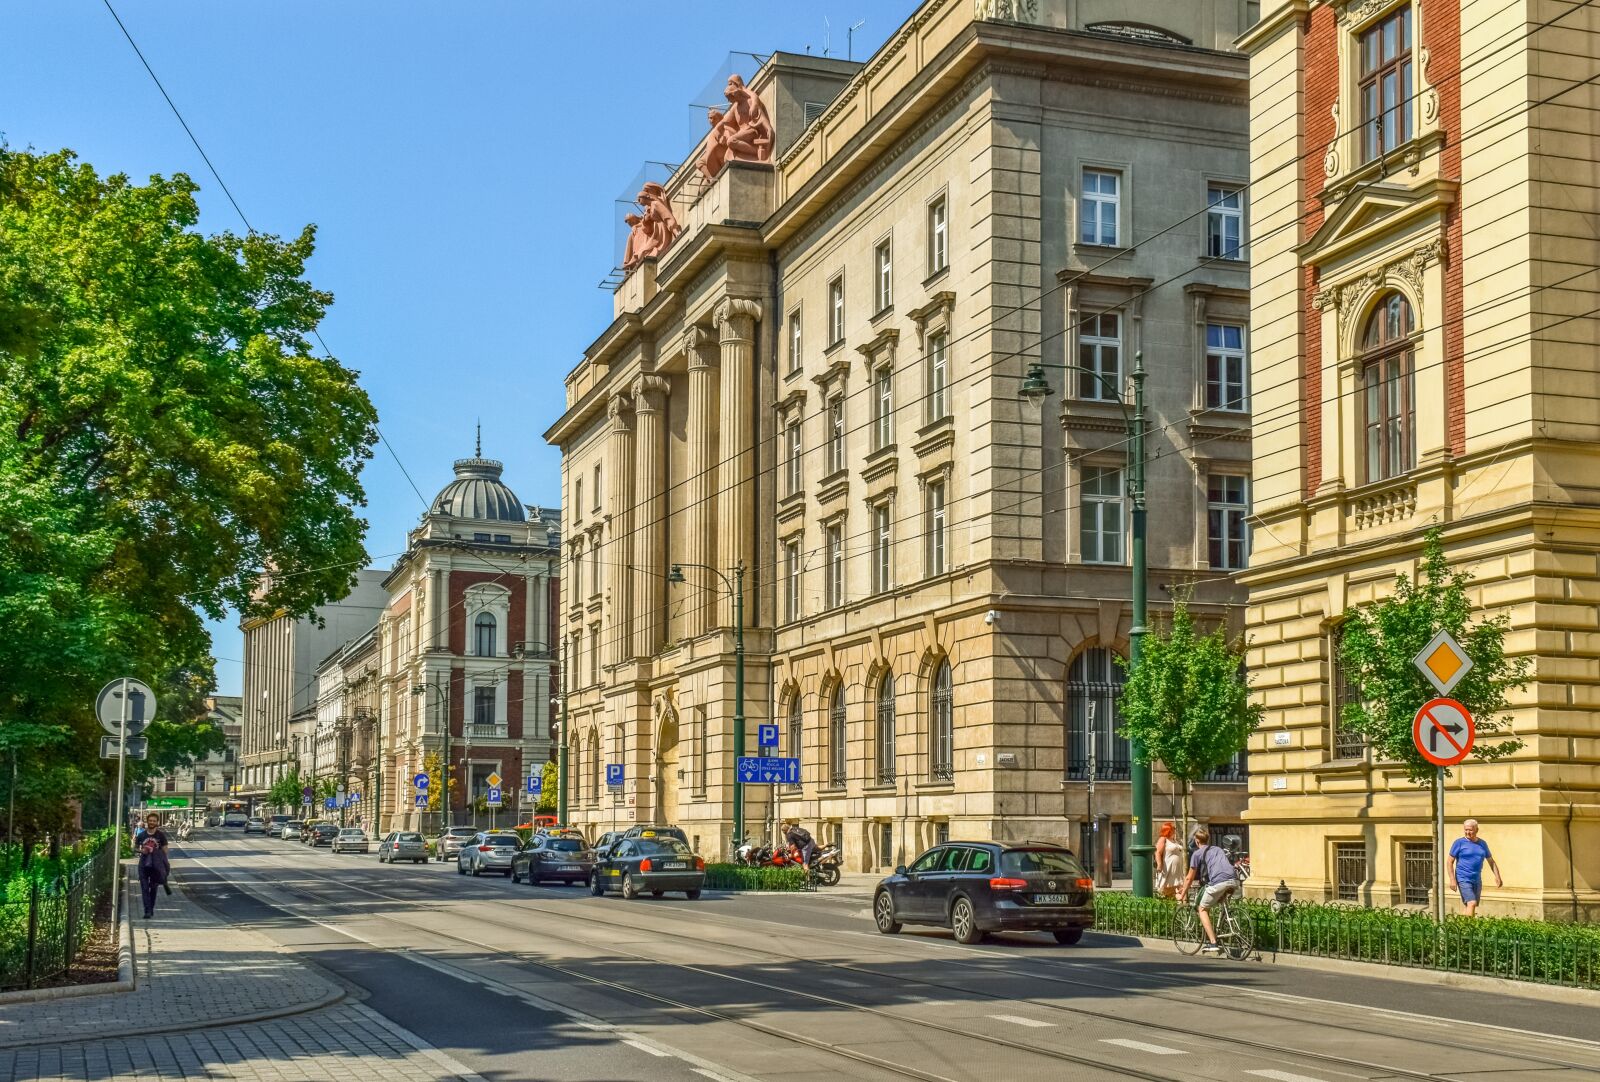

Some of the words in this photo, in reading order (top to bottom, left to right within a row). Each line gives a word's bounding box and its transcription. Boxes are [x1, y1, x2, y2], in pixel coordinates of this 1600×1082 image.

[763, 726, 775, 744] P
[610, 765, 621, 779] P
[530, 777, 539, 789] P
[490, 789, 499, 801] P
